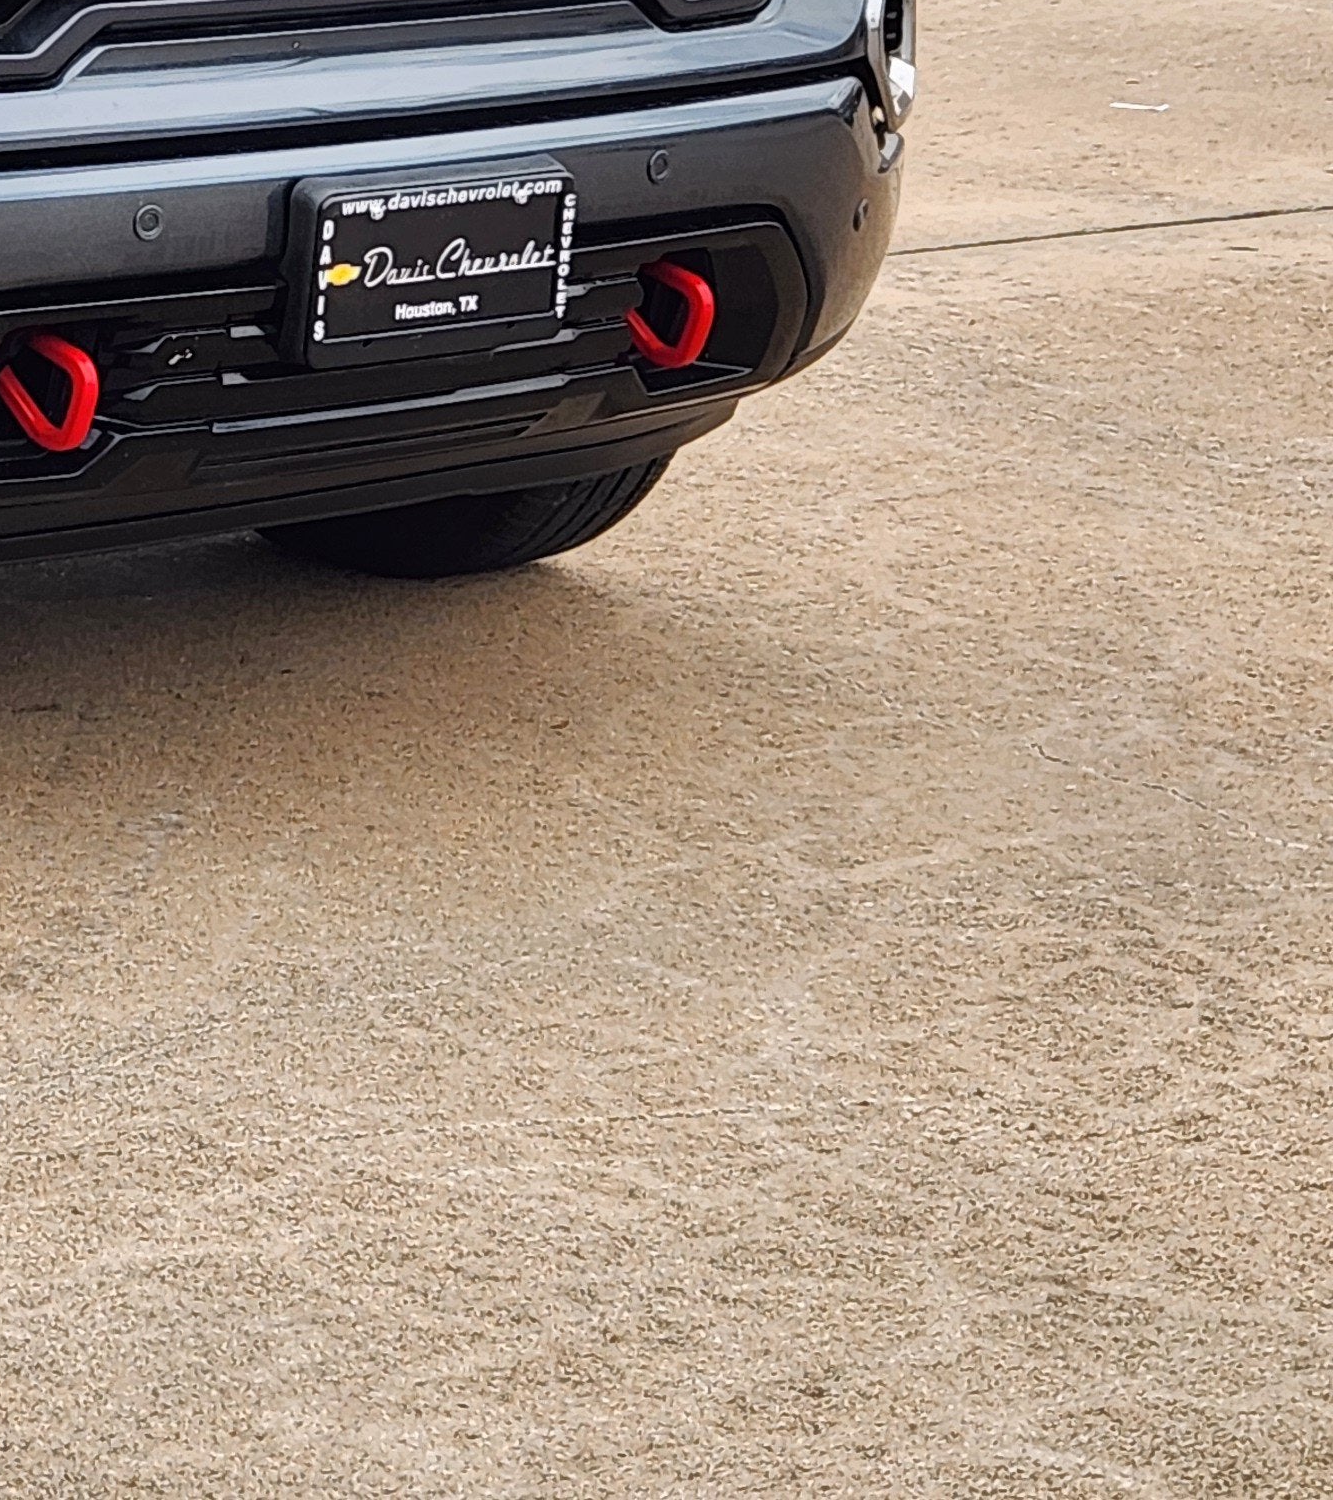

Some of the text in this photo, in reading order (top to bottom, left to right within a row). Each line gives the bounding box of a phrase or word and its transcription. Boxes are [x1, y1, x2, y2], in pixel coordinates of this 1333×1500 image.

[341, 179, 563, 218] www.davischevrolet.com
[312, 219, 335, 343] DAVIS
[363, 237, 556, 288] Davis Chevrolet
[554, 193, 577, 319] CHEVROLET
[394, 295, 479, 321] Houston, TX
